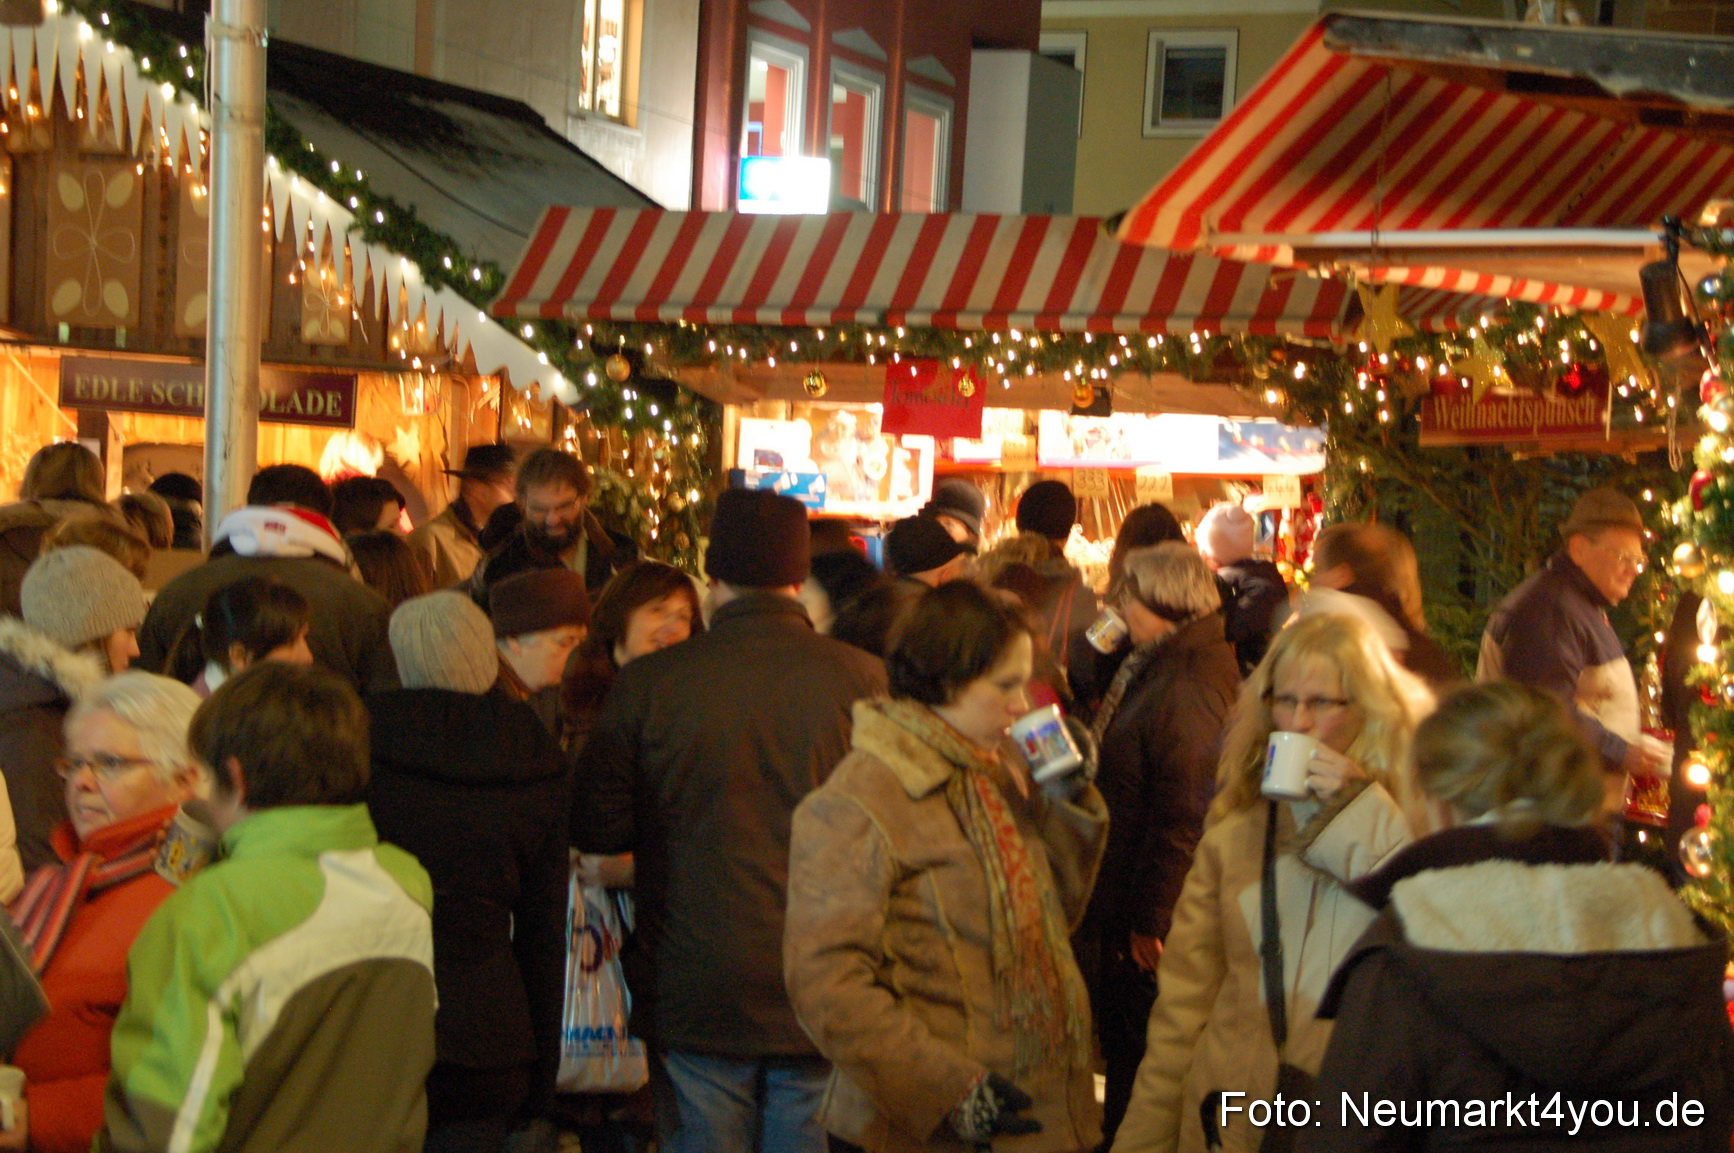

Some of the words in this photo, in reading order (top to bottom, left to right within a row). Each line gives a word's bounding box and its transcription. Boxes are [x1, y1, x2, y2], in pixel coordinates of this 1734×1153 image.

[75, 373, 143, 403] EDLE
[151, 379, 342, 418] SCHLADE
[1433, 392, 1596, 435] Weihnachtspunsch
